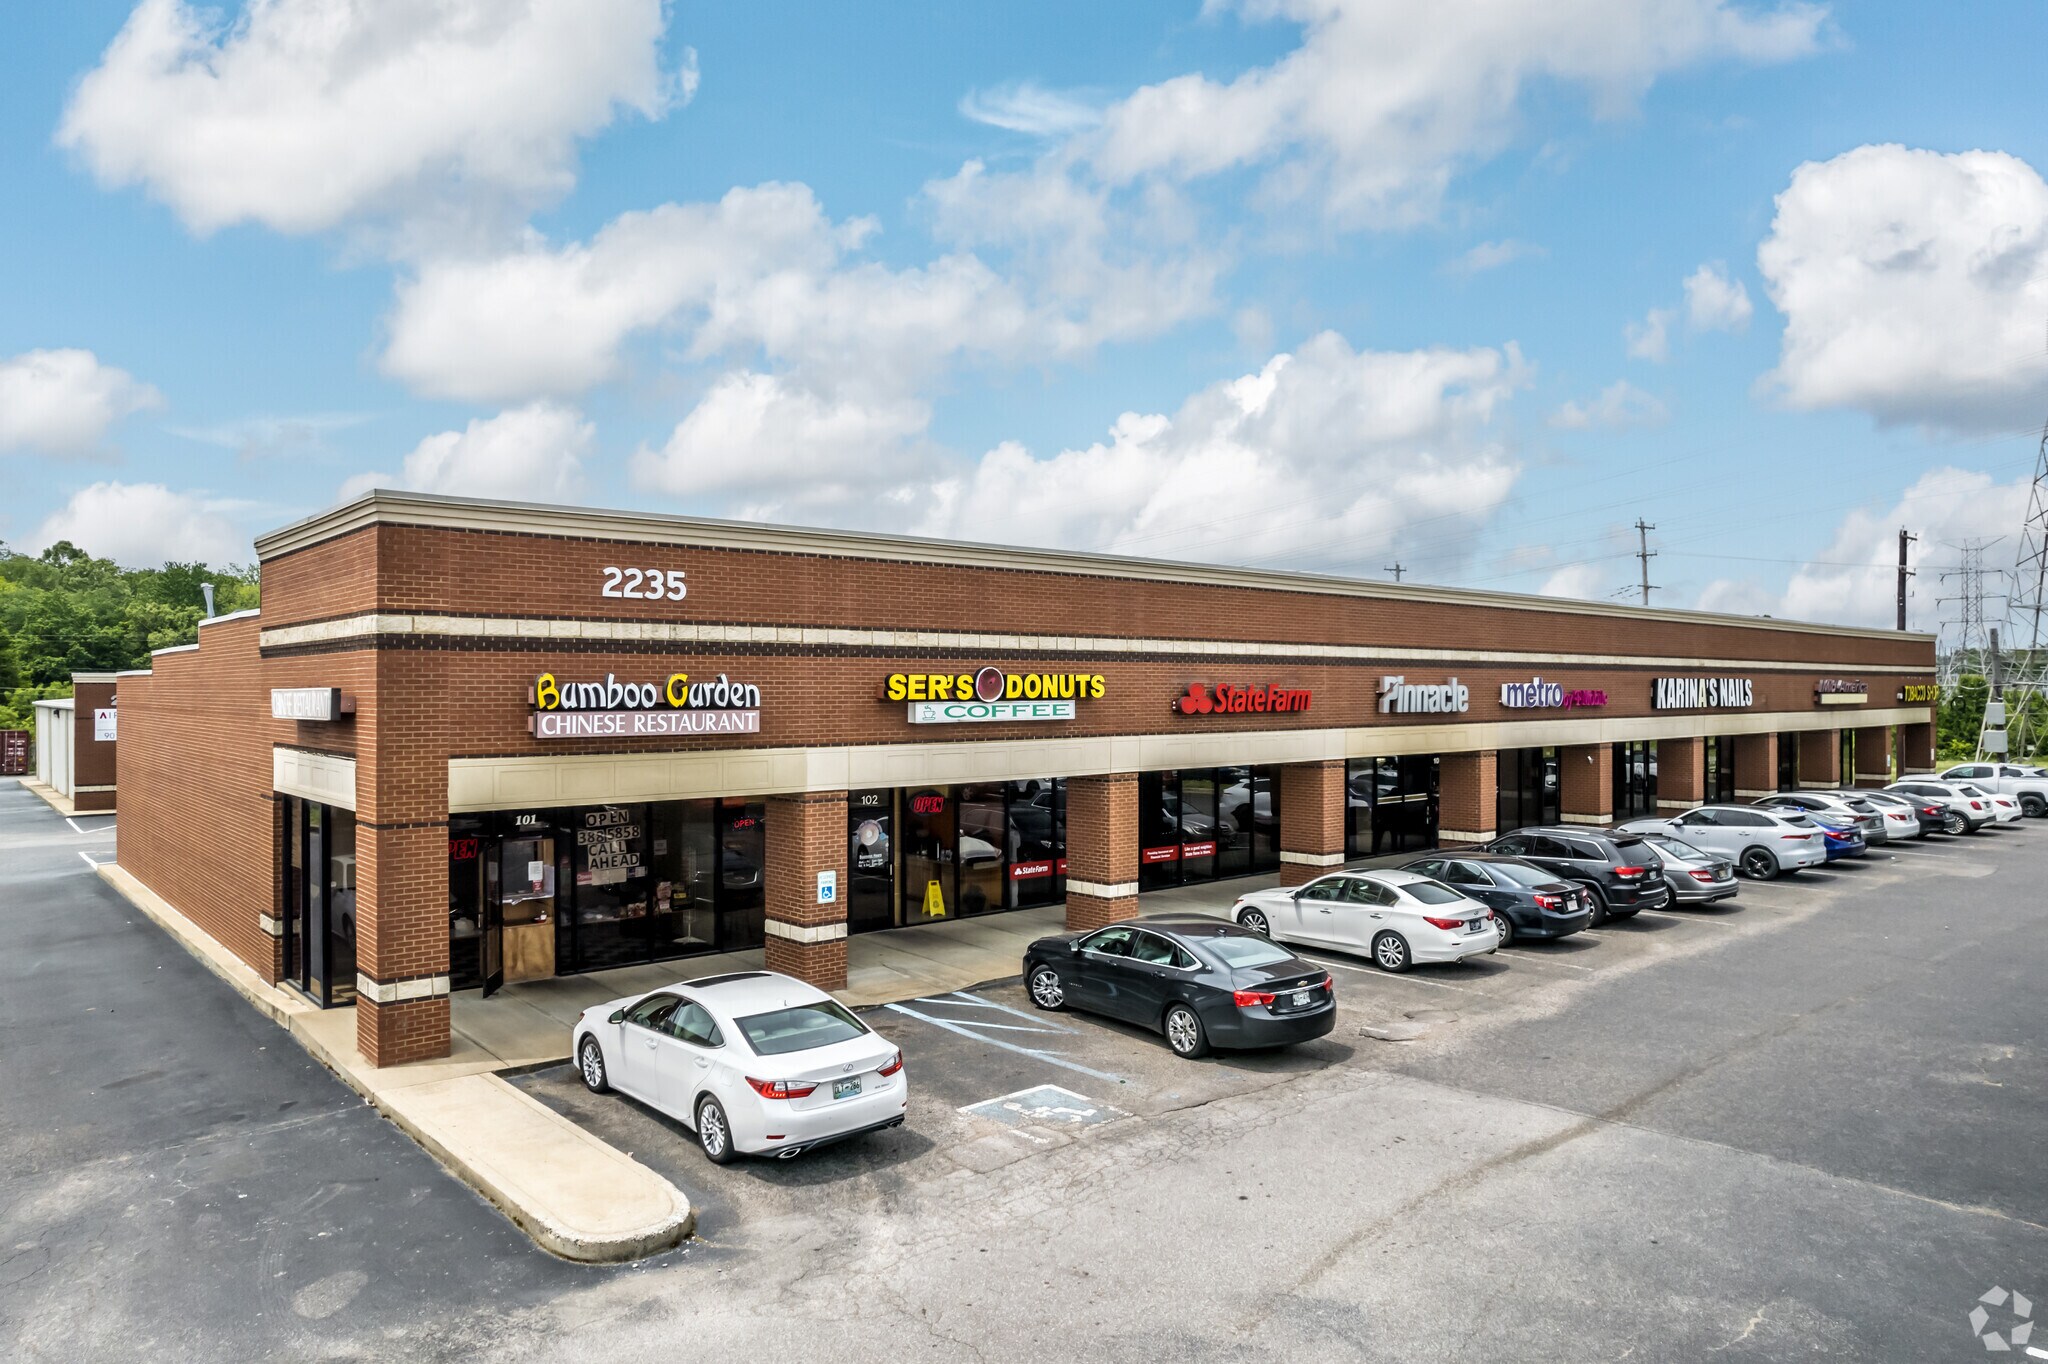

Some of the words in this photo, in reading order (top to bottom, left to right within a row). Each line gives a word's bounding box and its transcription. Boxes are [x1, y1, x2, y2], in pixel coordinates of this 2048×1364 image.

[602, 566, 687, 601] 2235
[536, 673, 657, 710] Bamboo
[664, 673, 760, 709] Garden
[887, 674, 974, 701] SER'S
[1005, 674, 1106, 699] DONUTS
[1379, 675, 1469, 713] Pinnacle
[1502, 677, 1563, 707] metro
[1656, 678, 1718, 709] KARINA'S
[1719, 678, 1753, 707] NAILS
[944, 704, 1071, 719] COFFEE
[541, 713, 625, 735] CHINESE
[634, 712, 756, 734] RESTAURANT
[861, 795, 879, 805] 102
[914, 796, 944, 813] OPEN
[515, 814, 537, 826] 101
[586, 810, 628, 827] OPEN
[734, 818, 755, 829] OPEN
[448, 838, 478, 860] PEN
[588, 840, 625, 857] CALL
[590, 853, 639, 870] AHEAD
